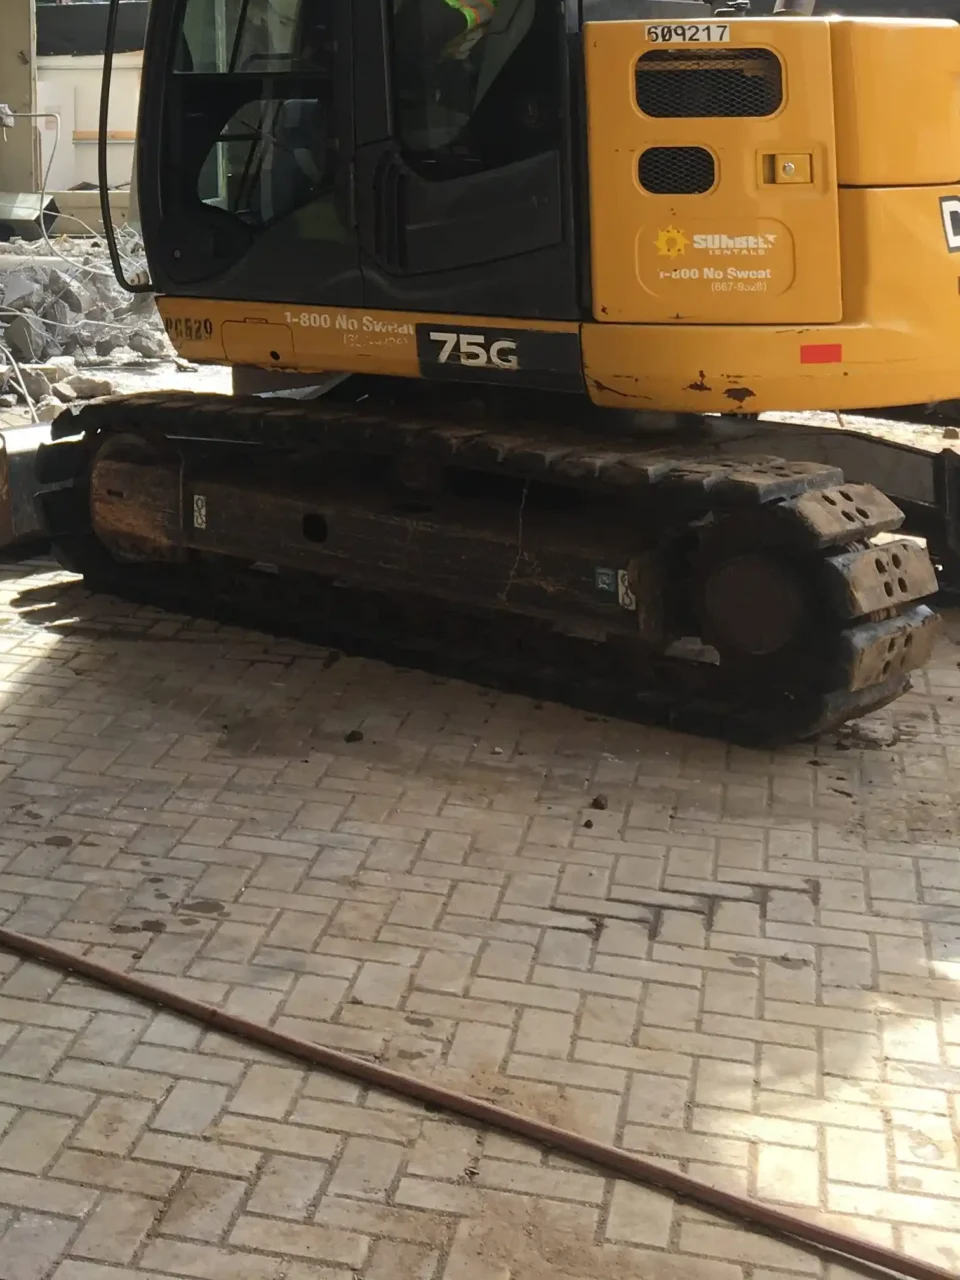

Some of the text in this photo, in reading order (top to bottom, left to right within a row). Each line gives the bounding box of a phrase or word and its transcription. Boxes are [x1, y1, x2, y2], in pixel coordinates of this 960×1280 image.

[647, 25, 728, 42] 609217
[703, 267, 724, 280] No
[726, 267, 772, 280] Sweat
[283, 311, 415, 336] 1-800 No Sweat
[429, 331, 518, 370] 75G
